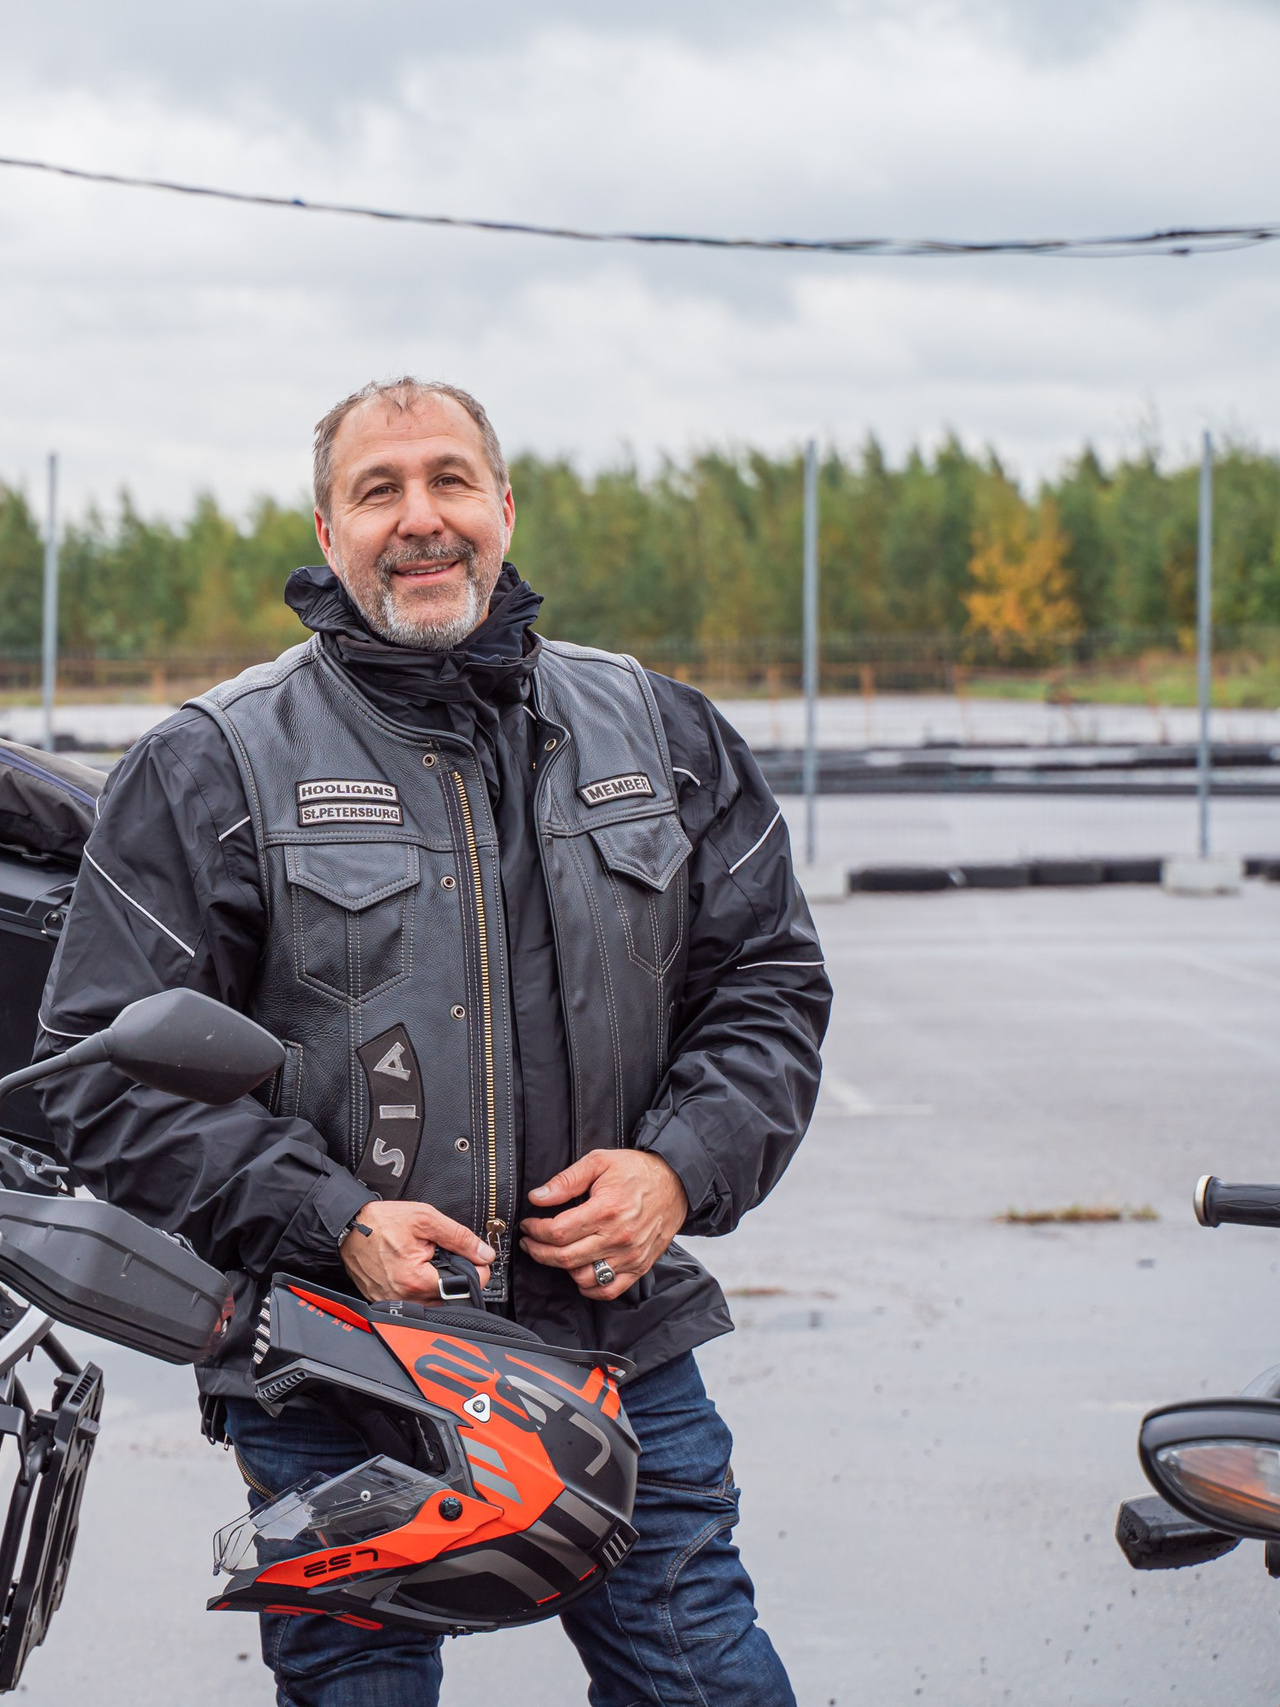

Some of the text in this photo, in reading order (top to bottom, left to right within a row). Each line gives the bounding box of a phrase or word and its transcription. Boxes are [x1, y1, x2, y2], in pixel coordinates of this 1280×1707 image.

[301, 784, 394, 798] HOOLIGANS
[587, 778, 650, 800] MEMBER
[366, 1042, 417, 1186] SIA
[303, 1548, 379, 1578] LS2
